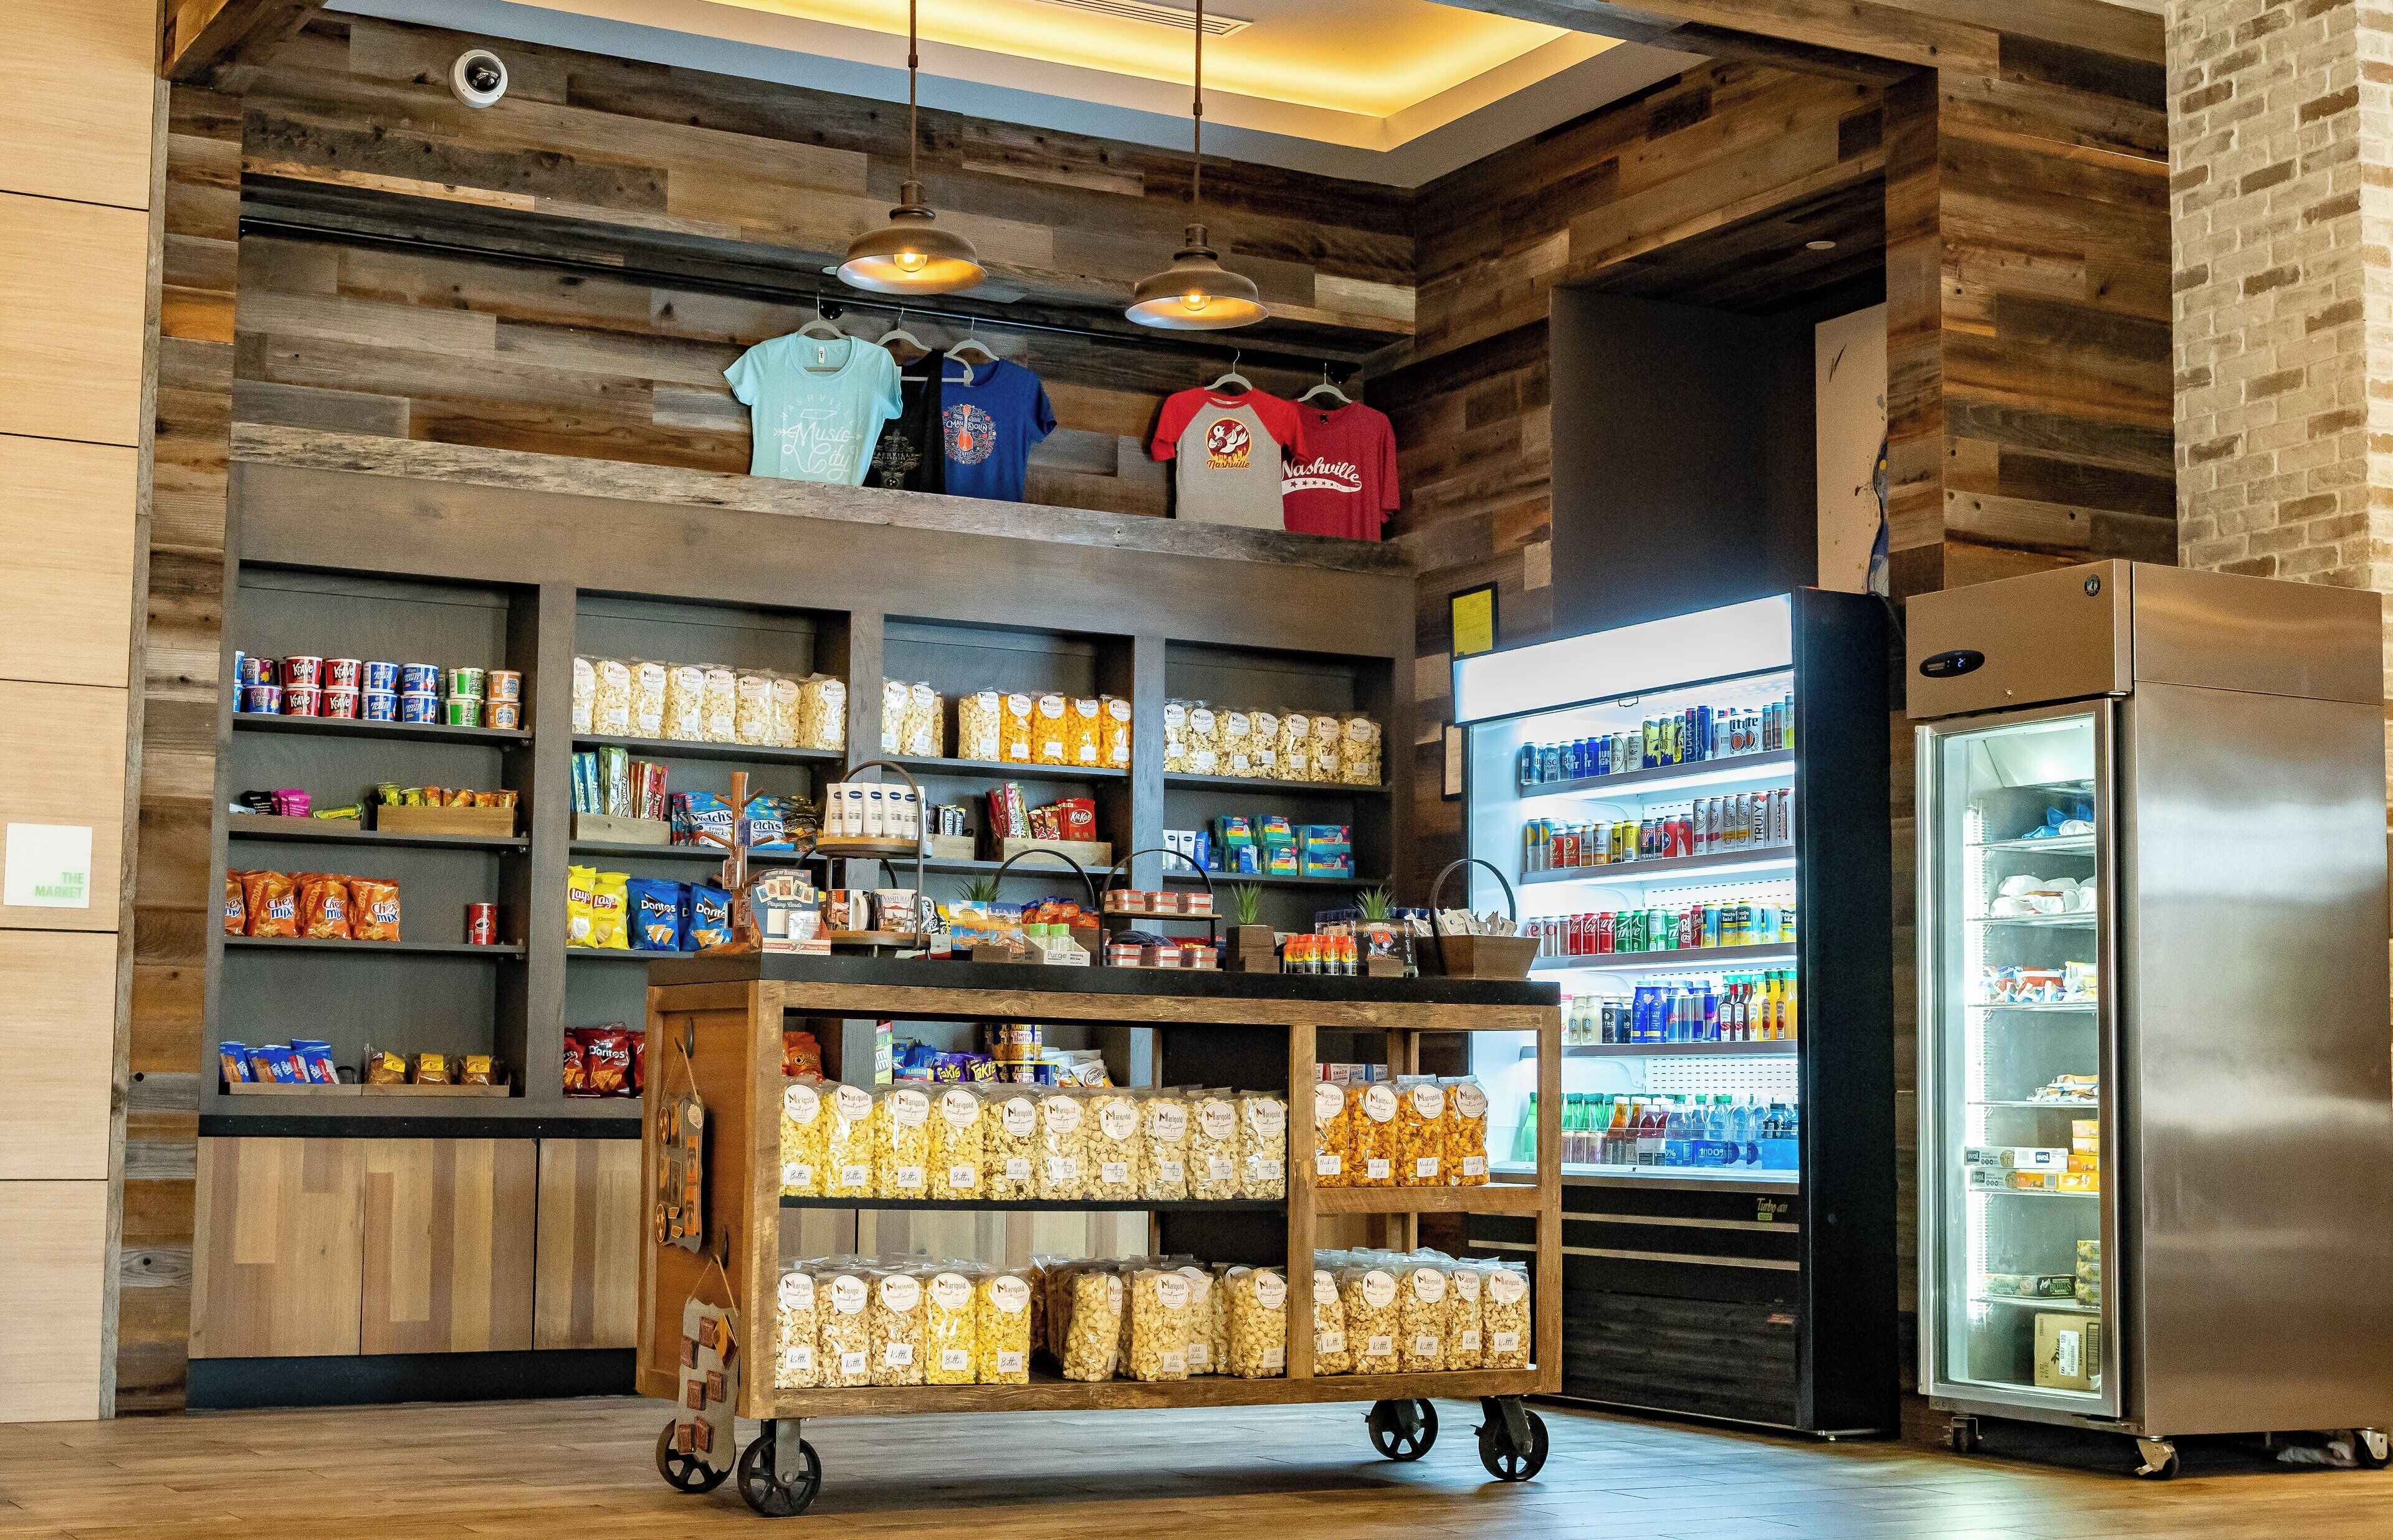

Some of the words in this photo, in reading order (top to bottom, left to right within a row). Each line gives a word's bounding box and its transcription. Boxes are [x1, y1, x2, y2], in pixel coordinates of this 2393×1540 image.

[787, 422, 851, 447] Music
[808, 443, 851, 481] City
[1206, 459, 1251, 470] Nashville
[1281, 457, 1360, 482] Nashville
[690, 812, 732, 823] Welch's
[753, 822, 782, 831] elch's
[1754, 805, 1764, 843] TRULY
[61, 872, 84, 884] THE
[34, 885, 84, 898] MARKET
[571, 888, 591, 903] Lay's
[265, 895, 294, 910] Chex
[323, 896, 345, 909] Chex
[882, 894, 911, 902] NASHVILLE
[371, 902, 399, 915] Chex
[641, 900, 676, 913] Doritos
[270, 908, 293, 920] mix
[376, 912, 399, 923] mix
[1047, 951, 1067, 961] Purge
[588, 1045, 626, 1059] Doritos
[788, 1091, 814, 1105] Marigold
[841, 1090, 869, 1102] Marigold
[1416, 1091, 1441, 1103] Marigold
[1459, 1089, 1483, 1101] Marigold
[899, 1095, 925, 1108] Marigold
[947, 1096, 973, 1109] Marigold
[1008, 1106, 1033, 1118] Marigold
[1049, 1103, 1076, 1116] Marigold
[1105, 1110, 1132, 1121] Marigold
[1255, 1106, 1281, 1120] Marigold
[1158, 1111, 1183, 1125] Marigold
[1206, 1110, 1231, 1122] Marigold
[1053, 1160, 1073, 1169] Everything
[1163, 1162, 1181, 1172] Everything
[1211, 1161, 1230, 1170] Everything
[1259, 1161, 1278, 1171] Everything
[1319, 1158, 1339, 1166] Nashville
[1370, 1161, 1388, 1171] Nashville
[1419, 1159, 1437, 1169] Nashville
[1465, 1158, 1483, 1167] Nashville
[1063, 1167, 1076, 1177] Bagel
[1104, 1164, 1124, 1173] Everything
[1221, 1167, 1231, 1179] Bagel
[1268, 1167, 1278, 1178] Bagel
[1325, 1166, 1335, 1174] Hot
[1375, 1170, 1385, 1178] Hot
[1471, 1166, 1480, 1174] Hot
[790, 1169, 808, 1181] Butter
[844, 1169, 863, 1181] Butter
[900, 1172, 918, 1182] Butter
[953, 1171, 972, 1182] Butter
[1114, 1171, 1125, 1181] Bagel
[1172, 1169, 1181, 1181] Bagel
[1757, 1197, 1776, 1212] Turbo
[1776, 1202, 1789, 1214] air
[785, 1278, 811, 1291] Marigold
[938, 1278, 967, 1290] Marigold
[1160, 1278, 1185, 1291] Marigold
[1258, 1280, 1282, 1291] Marigold
[1367, 1278, 1392, 1290] Marigold
[1494, 1275, 1520, 1287] Marigold
[836, 1284, 863, 1296] Marigo
[996, 1283, 1025, 1294] Marigold
[1326, 1337, 1339, 1348] Kettle
[1373, 1341, 1388, 1351] Kettle
[1420, 1341, 1434, 1351] Kettle
[1465, 1336, 1477, 1345] Kettle
[1498, 1337, 1514, 1347] Kettle
[790, 1352, 806, 1364] Kettle
[890, 1349, 908, 1360] Kettle
[945, 1354, 963, 1365] Butter
[845, 1357, 862, 1369] Kettle
[1000, 1356, 1018, 1367] Butter
